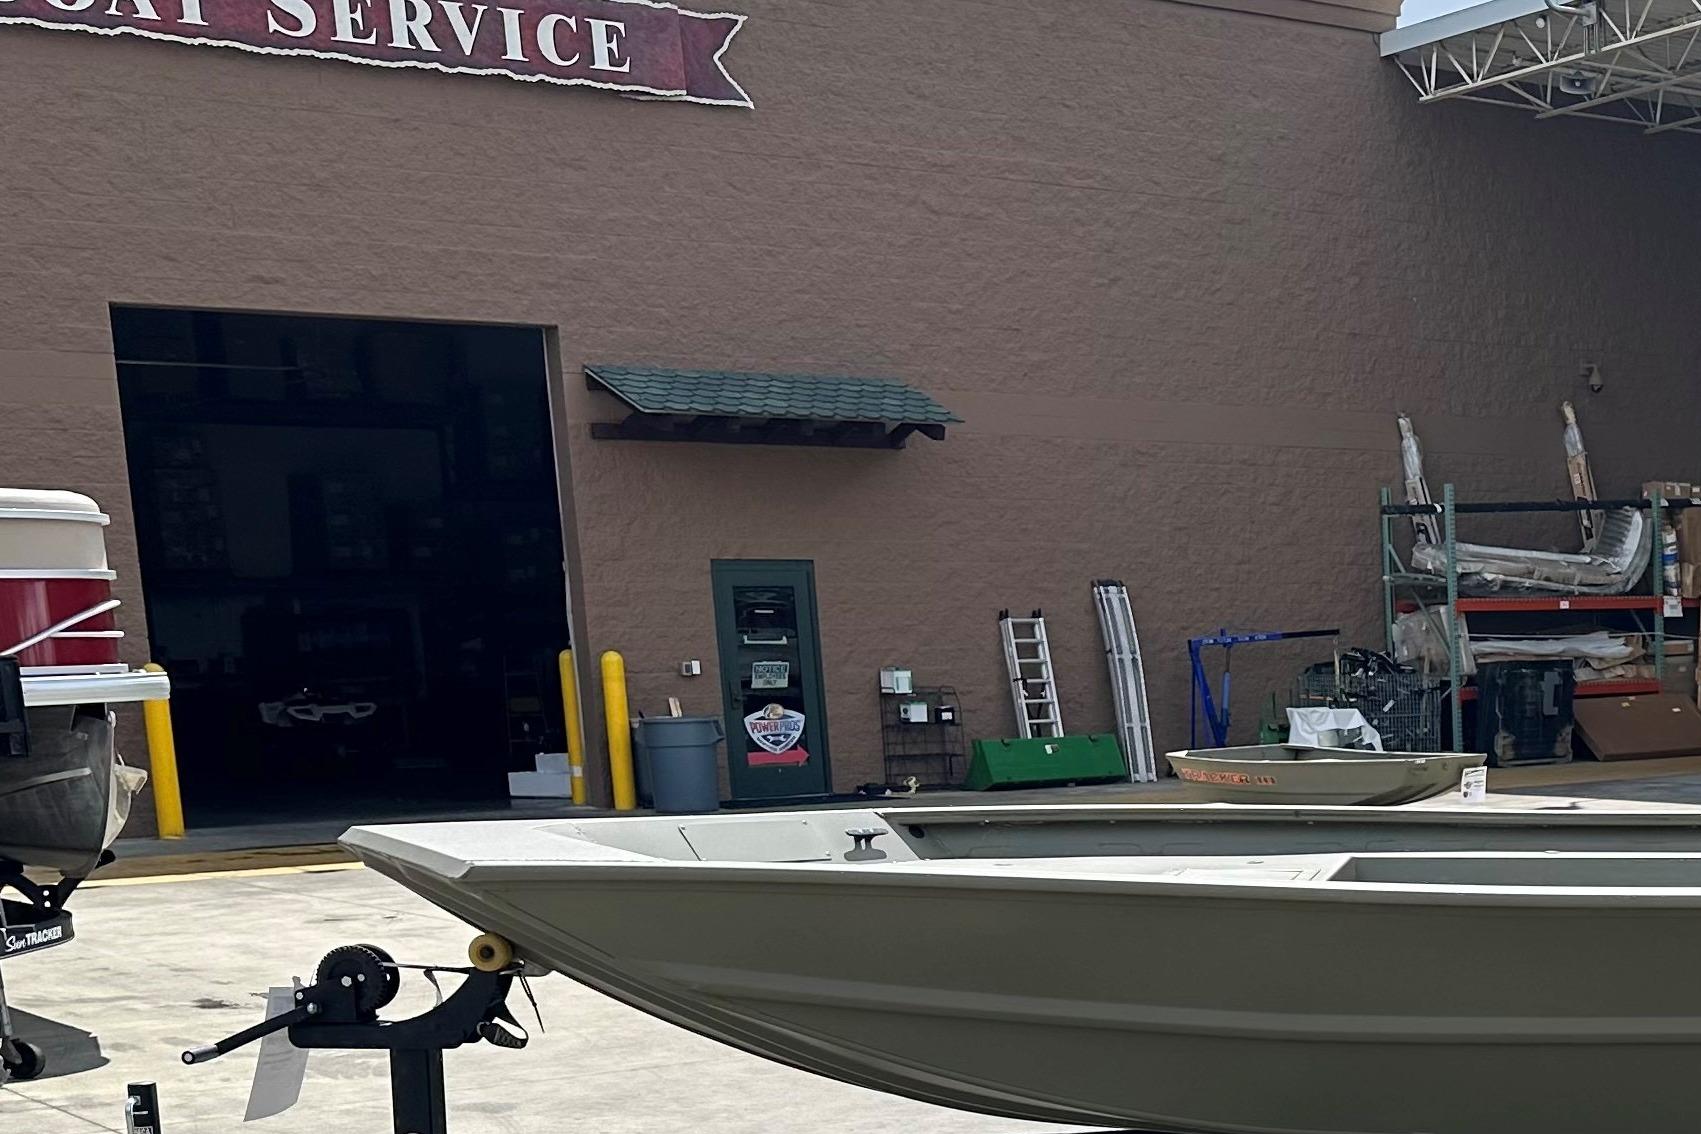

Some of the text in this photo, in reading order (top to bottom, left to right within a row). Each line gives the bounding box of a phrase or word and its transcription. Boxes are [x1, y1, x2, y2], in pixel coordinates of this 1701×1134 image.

[266, 0, 631, 73] SERVICE
[755, 665, 786, 673] NOTICE
[25, 925, 62, 947] TRACKER
